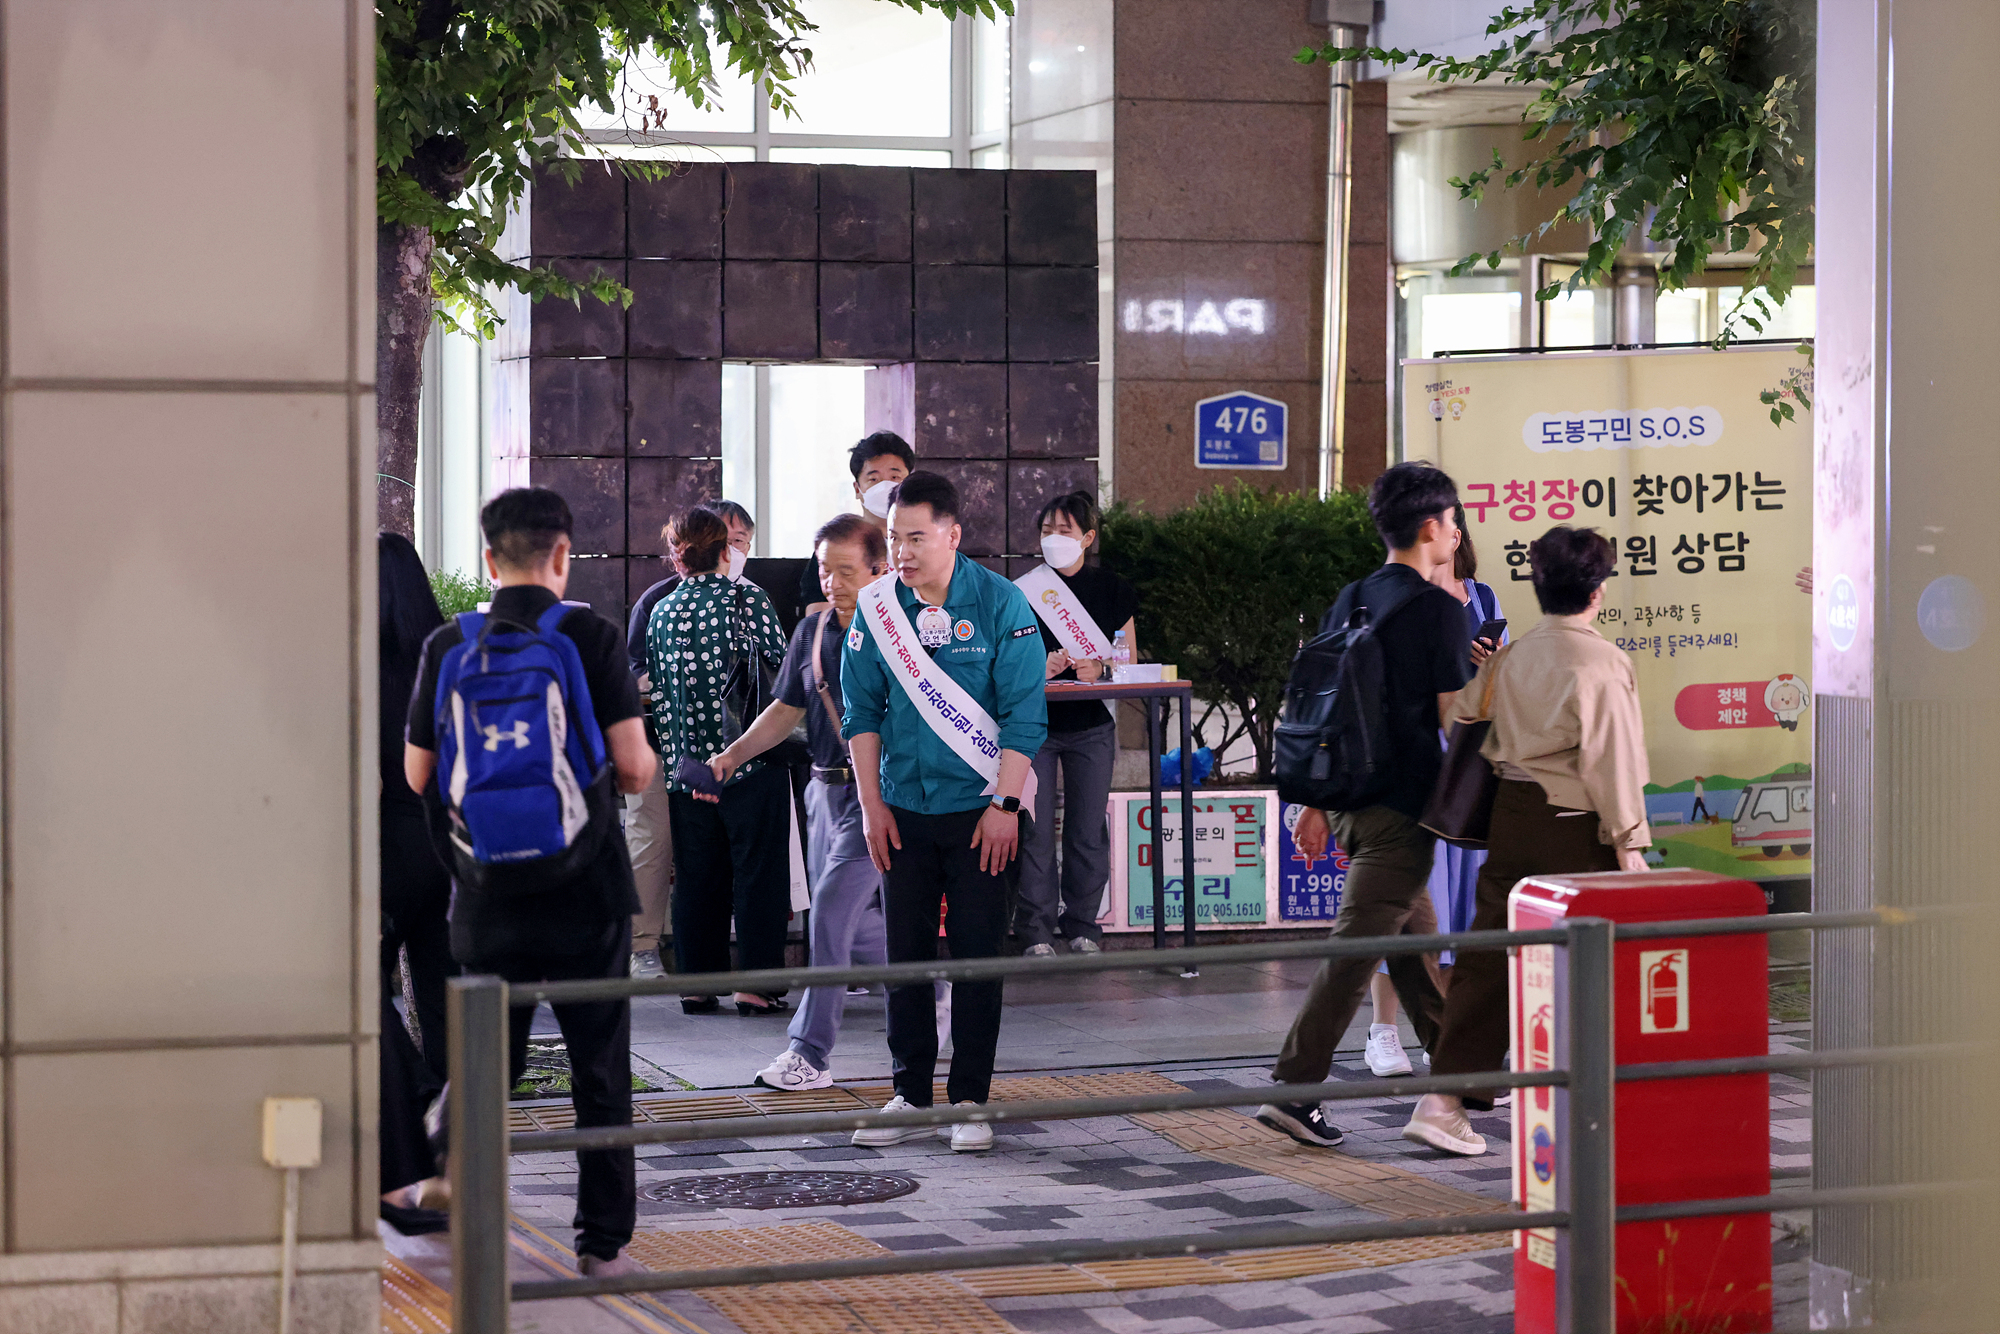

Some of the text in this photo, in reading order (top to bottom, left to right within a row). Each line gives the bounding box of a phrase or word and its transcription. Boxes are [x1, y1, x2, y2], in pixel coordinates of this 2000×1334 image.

[1215, 407, 1268, 434] 476
[1541, 415, 1706, 445] 도봉구민 S.O.S
[1463, 470, 1787, 524] 구청장이 찾아가는
[1504, 531, 1751, 582] 현원 상담
[1634, 604, 1685, 627] 고충사항
[1691, 603, 1702, 625] 등
[1057, 608, 1097, 656] 구청장과
[1668, 632, 1739, 658] 들려주세요!
[875, 601, 1000, 760] 도봉구청장 현장민원 상담
[1717, 687, 1747, 705] 정책
[1717, 709, 1748, 726] 제안
[1287, 906, 1341, 917] 오피스텔 매
